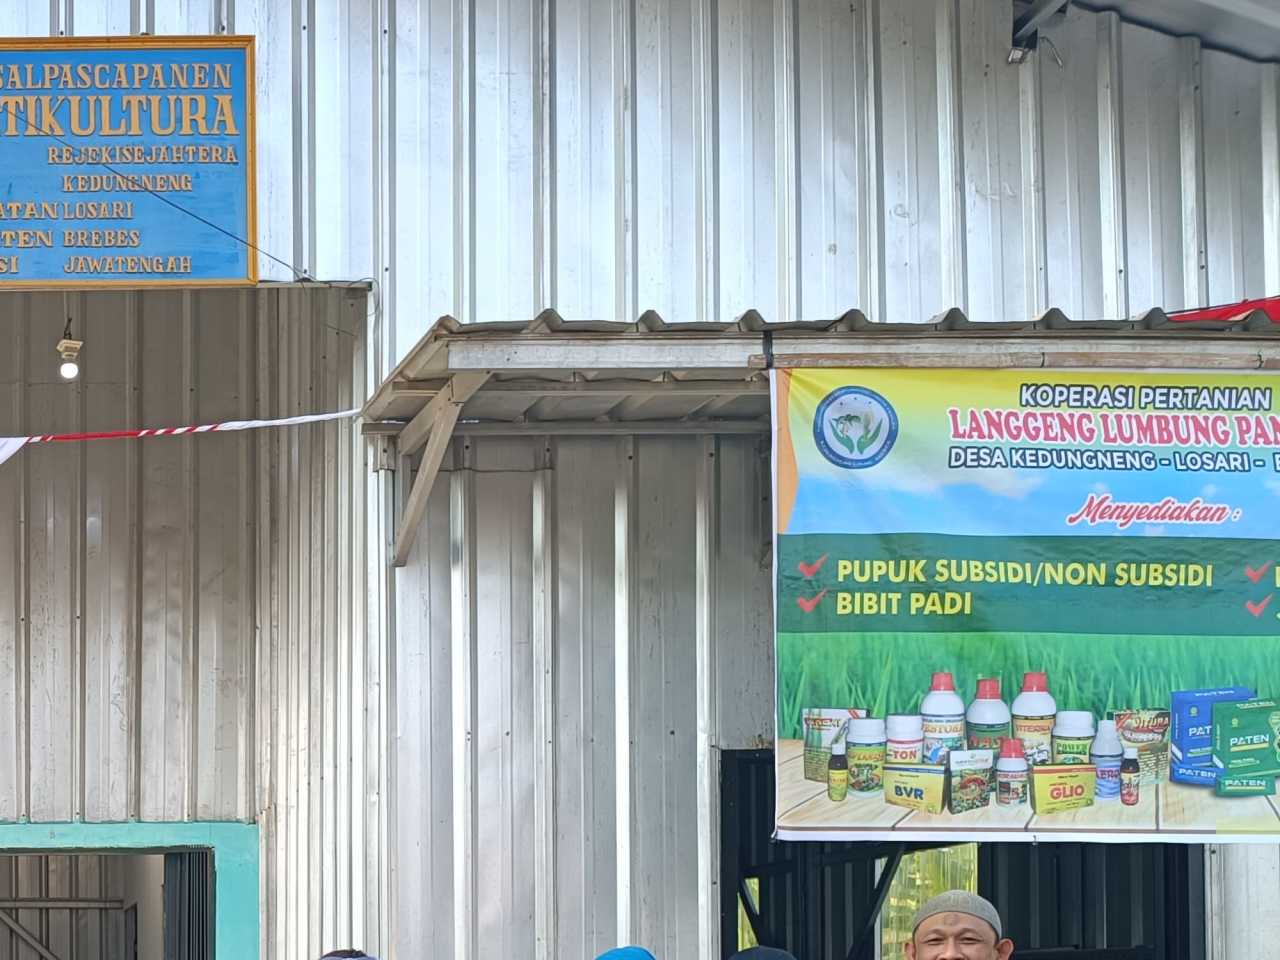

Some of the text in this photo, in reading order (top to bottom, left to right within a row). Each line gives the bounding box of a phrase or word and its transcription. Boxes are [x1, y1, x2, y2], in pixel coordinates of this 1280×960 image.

[63, 174, 193, 192] KEDUNGNENG
[63, 201, 135, 220] LOSARI
[63, 230, 141, 248] BREBES
[63, 256, 193, 273] JAWATENGAH
[1021, 384, 1272, 410] KOPERASI PERTANIAN
[949, 409, 1096, 443] LANGGENG
[1099, 413, 1232, 446] LUMBUNG
[949, 447, 1007, 468] DESA
[1011, 448, 1156, 471] KEDUNGNENG
[1174, 451, 1250, 472] LOSARI
[1067, 493, 1230, 529] Menyediakan
[837, 559, 1213, 587] PUPUK SUBSIDI/NON SUBSIDI
[836, 592, 972, 615] BIBIT PADI
[1230, 734, 1270, 746] PATEN
[892, 750, 918, 760] TON
[1178, 768, 1217, 779] PATEN
[1050, 784, 1085, 800] GLIO
[1224, 779, 1267, 787] PATEN
[894, 785, 925, 801] BVR
